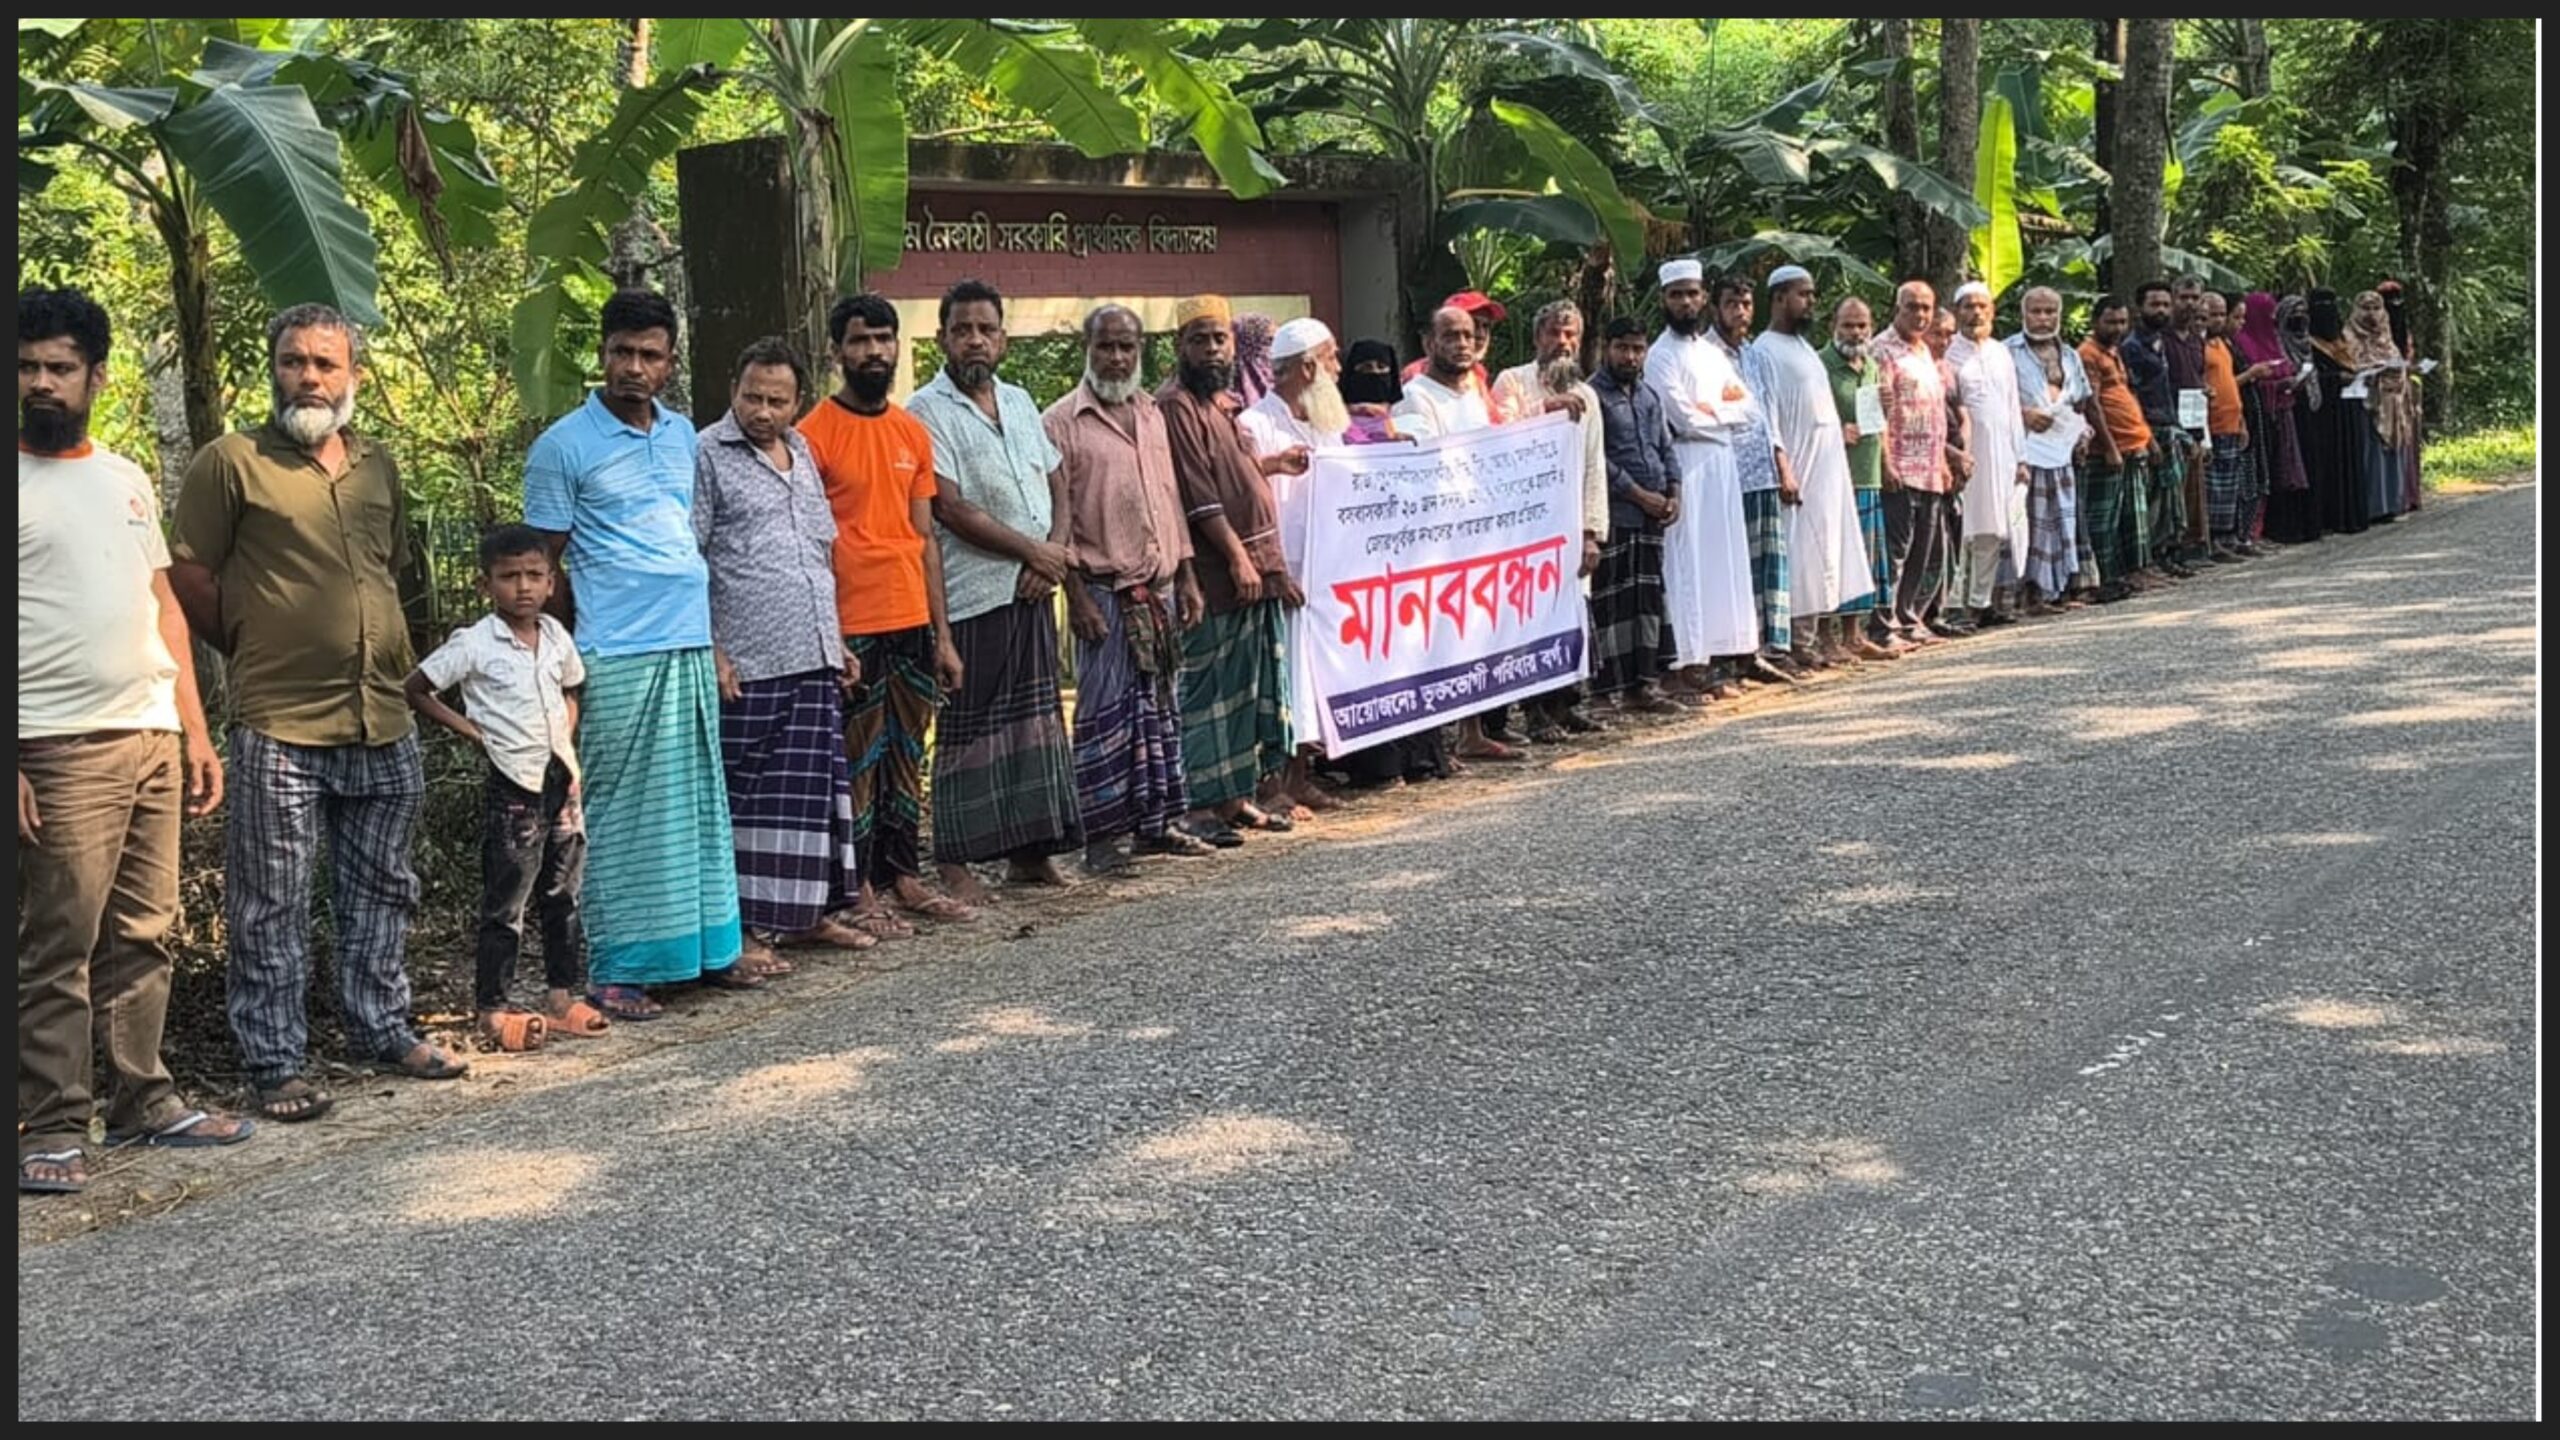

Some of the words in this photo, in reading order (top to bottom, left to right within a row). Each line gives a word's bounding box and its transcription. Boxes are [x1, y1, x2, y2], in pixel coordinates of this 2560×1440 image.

[924, 204, 991, 252] নৈকাঠী
[996, 211, 1068, 252] সরকারি
[1072, 212, 1141, 257] প্রাথমিক
[1147, 213, 1217, 253] বিদ্যালয়
[1331, 535, 1568, 663] মানববন্ধন
[1419, 663, 1491, 712] ভুক্তভোগী
[1491, 652, 1537, 685] পরিবার
